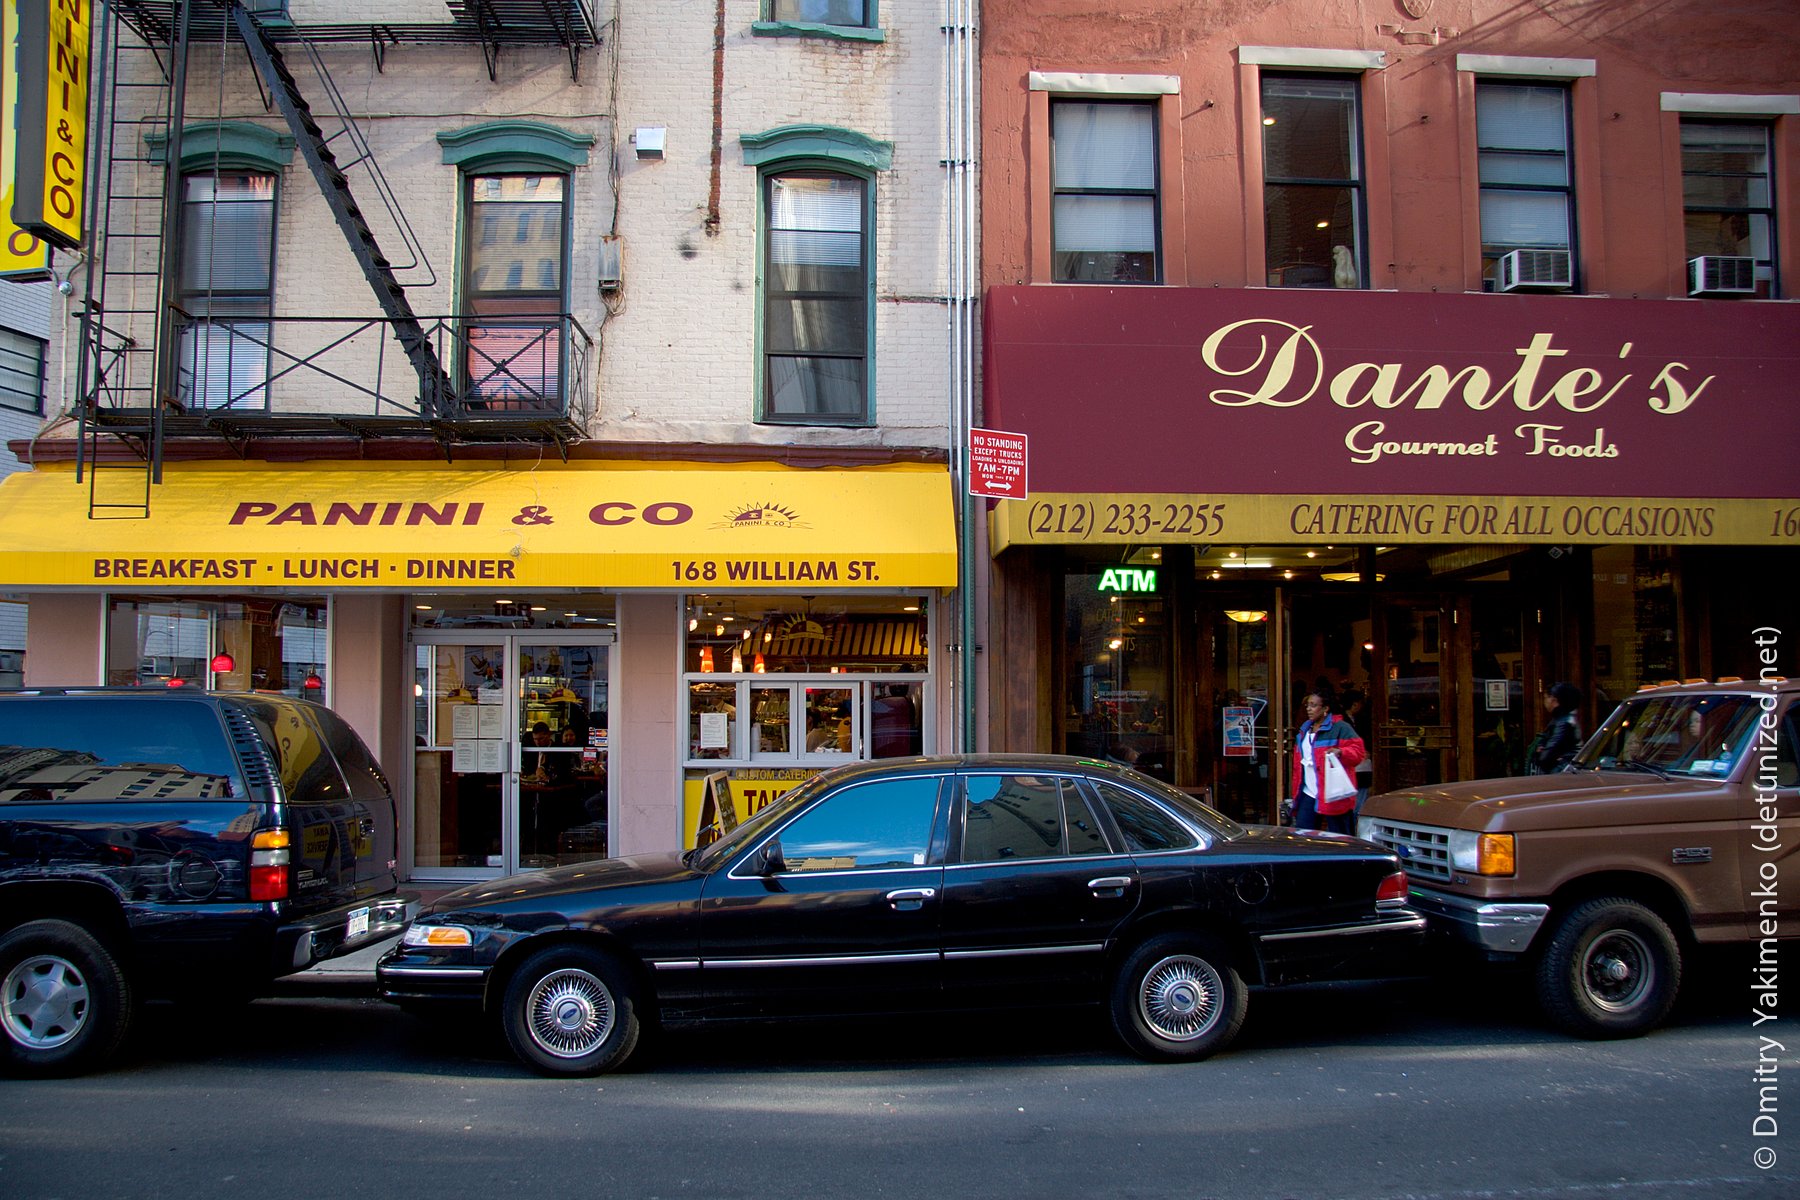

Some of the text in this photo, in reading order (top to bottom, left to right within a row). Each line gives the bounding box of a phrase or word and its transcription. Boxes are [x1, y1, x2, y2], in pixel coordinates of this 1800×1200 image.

[57, 118, 74, 146] &
[50, 151, 76, 220] CO
[1201, 318, 1716, 414] Dante's
[974, 436, 1022, 449] NO STANDING
[974, 448, 1022, 459] EXCEPT TRUCKS
[1344, 420, 1619, 464] Gourmet Foods
[977, 463, 1020, 474] 7AM-7PM
[998, 458, 1024, 466] UNLOADING
[228, 502, 694, 526] PANINI & CO
[1028, 501, 1226, 540] (212) 233-2255
[1290, 503, 1715, 537] CATERING FOR ALL OCCASIONS
[1769, 507, 1800, 537] 16
[94, 559, 516, 579] BREAKFAST LUNCH DINNER
[671, 561, 880, 581] 168 WILLIAM ST.
[1098, 569, 1156, 592] ATM
[493, 603, 532, 617] 168
[735, 770, 775, 780] CUSTOM
